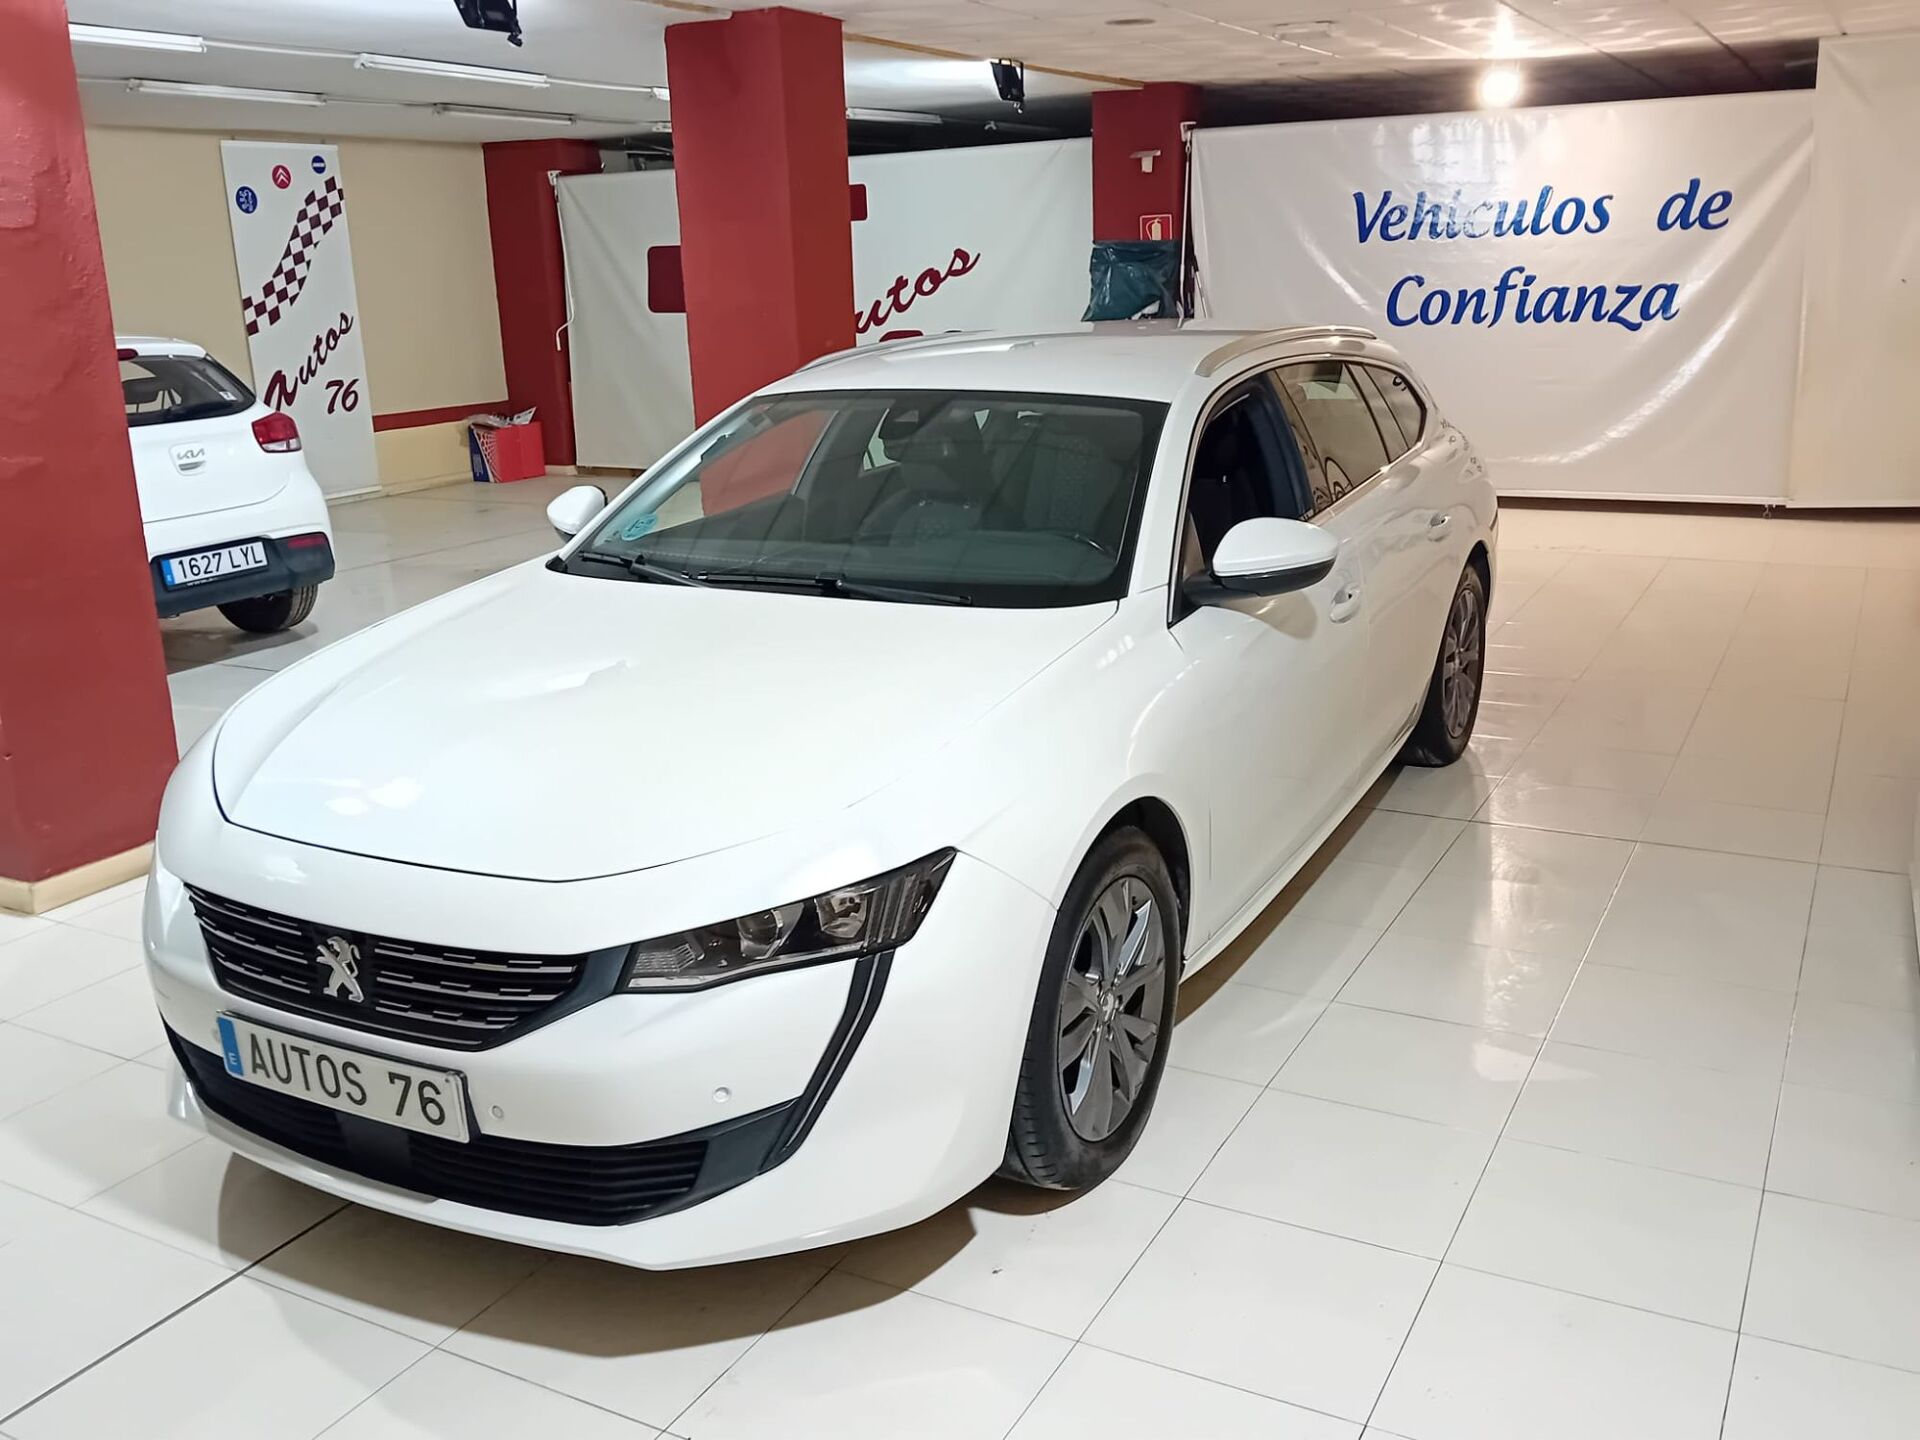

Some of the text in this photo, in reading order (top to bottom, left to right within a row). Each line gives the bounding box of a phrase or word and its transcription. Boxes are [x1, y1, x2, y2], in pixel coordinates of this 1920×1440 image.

[1656, 178, 1733, 232] de
[854, 248, 981, 334] utos
[1385, 266, 1680, 331] Confianza
[263, 312, 354, 412] Autos
[325, 378, 359, 414] 76
[178, 545, 264, 580] 1627 LYL
[250, 1033, 367, 1106] AUTOS
[388, 1071, 446, 1126] 76
